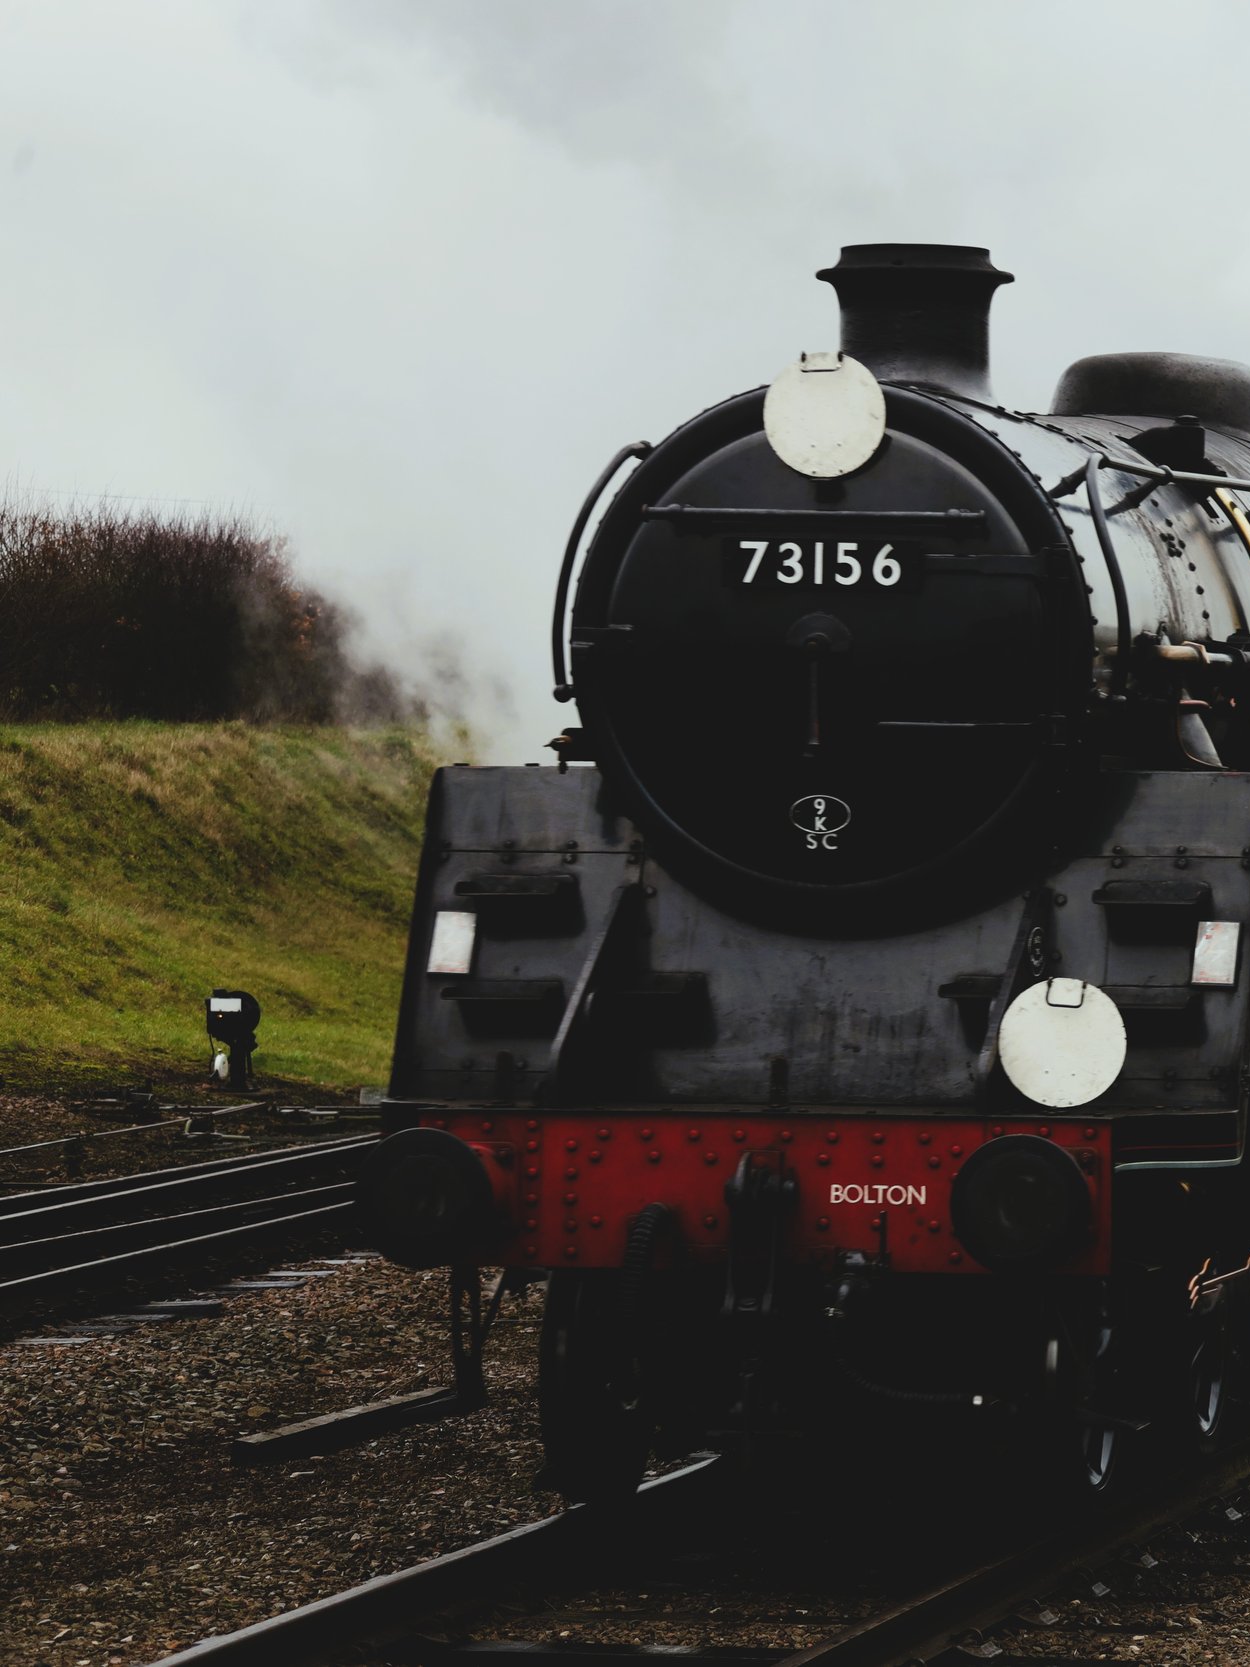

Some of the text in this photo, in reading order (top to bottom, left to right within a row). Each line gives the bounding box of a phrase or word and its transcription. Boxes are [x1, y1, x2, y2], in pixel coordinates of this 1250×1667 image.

[739, 540, 902, 586] 73156
[814, 798, 826, 815] 9
[814, 816, 827, 830] K
[806, 834, 838, 850] SC
[830, 1184, 926, 1205] BOLTON
